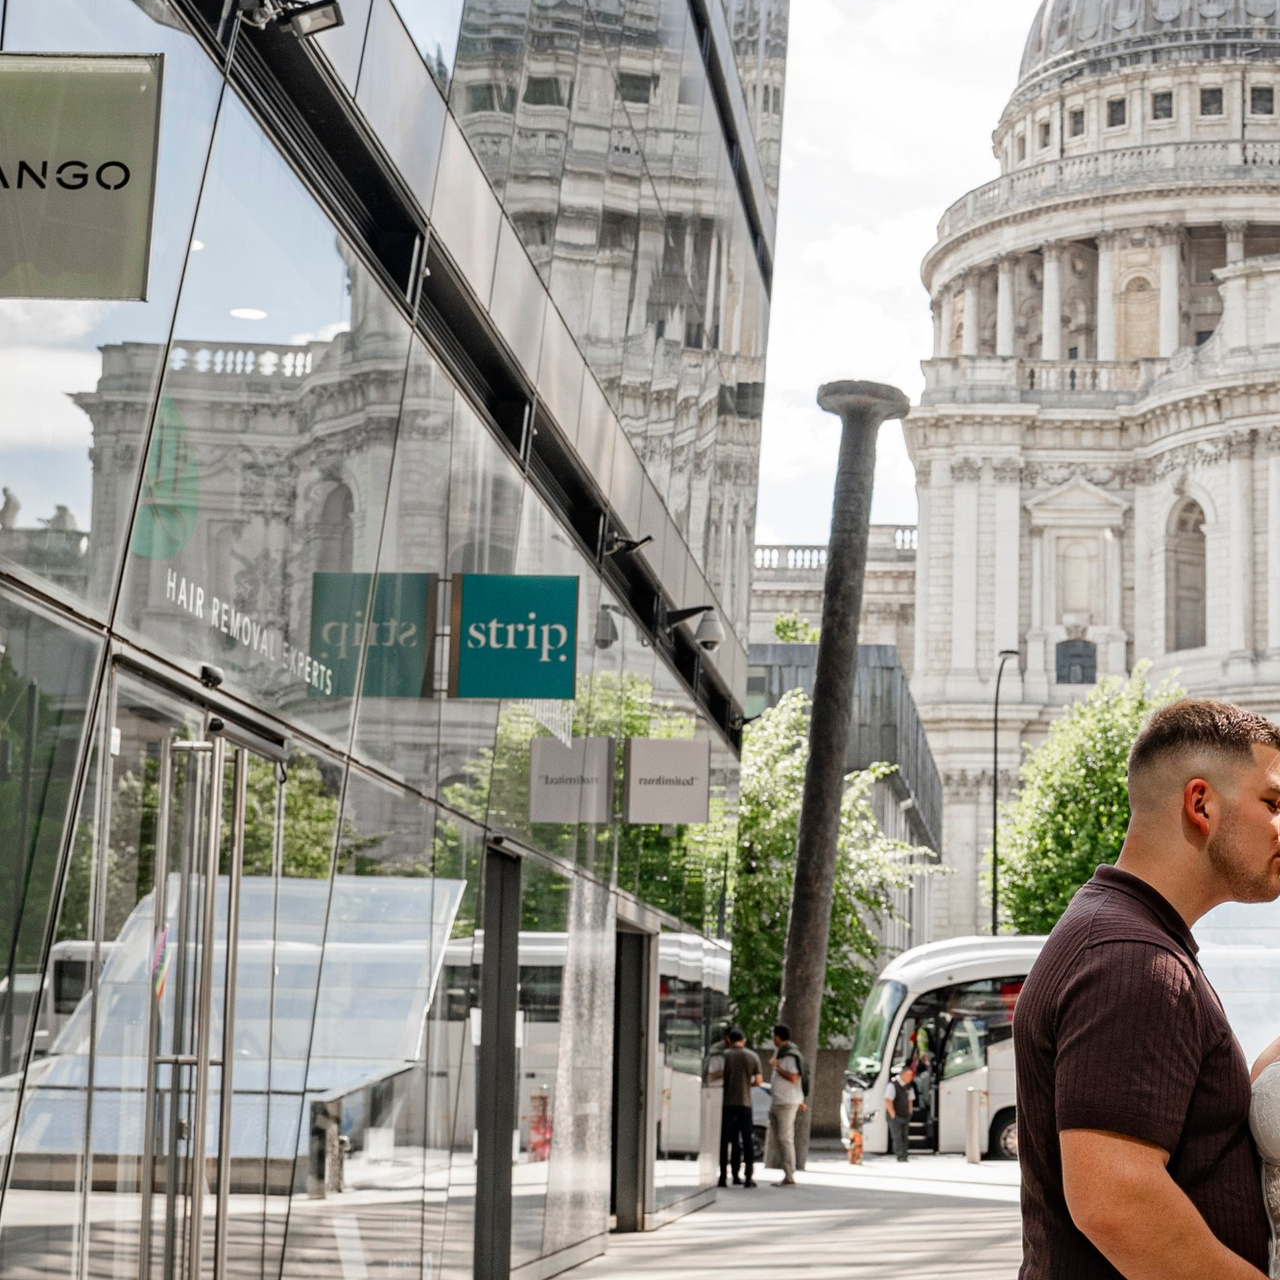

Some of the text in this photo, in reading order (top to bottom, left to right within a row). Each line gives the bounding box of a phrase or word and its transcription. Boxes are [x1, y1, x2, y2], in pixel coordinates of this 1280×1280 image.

[166, 567, 333, 696] HAIR REMOVAL EXPERTS
[467, 611, 569, 663] strip.
